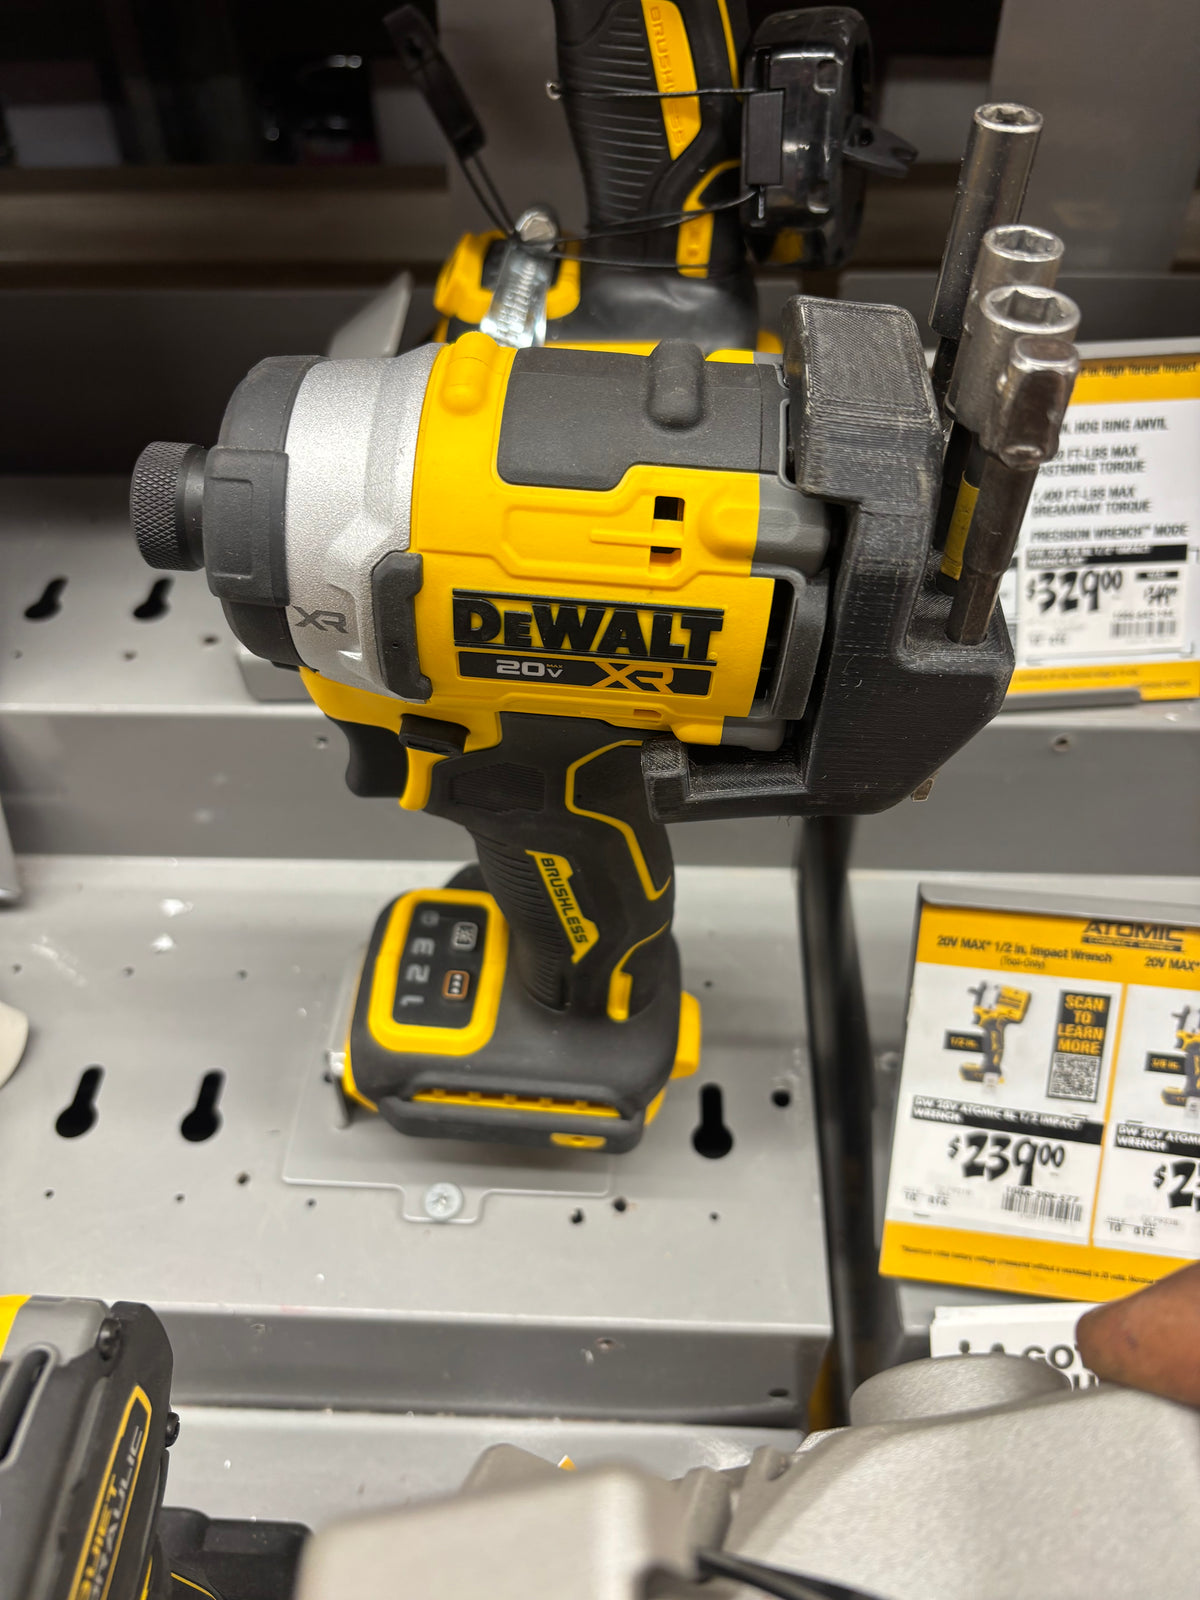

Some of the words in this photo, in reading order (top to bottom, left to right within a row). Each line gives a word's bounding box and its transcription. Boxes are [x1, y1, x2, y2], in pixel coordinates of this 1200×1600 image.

[1102, 420, 1130, 431] RING
[1133, 418, 1168, 430] ANVIL
[1111, 446, 1137, 457] MAX
[1039, 462, 1096, 476] ASTENING
[1100, 461, 1145, 473] TORQUE
[1109, 487, 1135, 497] MAX
[1106, 501, 1150, 513] TORQUE
[1032, 528, 1090, 541] PRECISION
[1153, 524, 1188, 536] MODE
[291, 605, 349, 634] XR
[592, 661, 674, 694] XR
[541, 857, 588, 944] BRUSHLESS
[1083, 919, 1185, 942] ATOMIC
[411, 937, 435, 957] 3
[937, 935, 958, 947] 20V
[995, 942, 1012, 953] 1/2
[1030, 945, 1068, 960] Impact
[1071, 949, 1112, 963] Wrench
[1145, 956, 1167, 968] 20V
[406, 964, 430, 983] 2
[400, 994, 424, 1006] 1
[1065, 993, 1104, 1012] SCAN
[1073, 1010, 1092, 1025] TO
[1057, 1023, 1105, 1042] LEARN
[1057, 1038, 1102, 1055] MORE
[1153, 1159, 1200, 1212] $2
